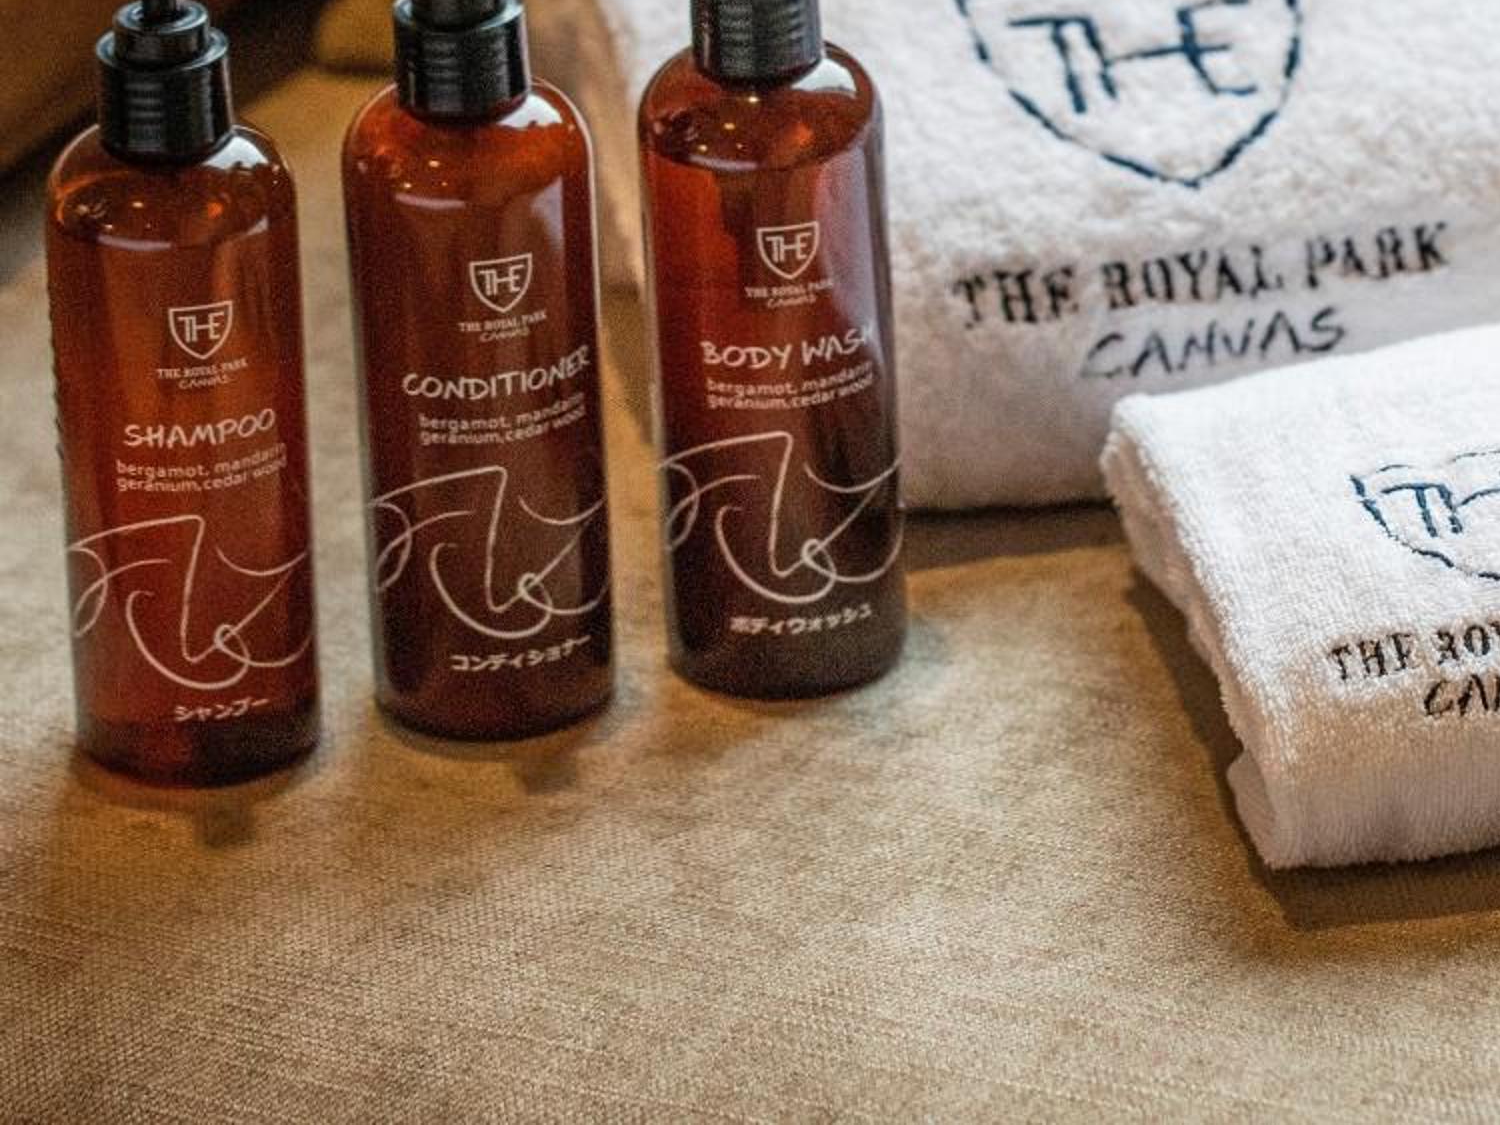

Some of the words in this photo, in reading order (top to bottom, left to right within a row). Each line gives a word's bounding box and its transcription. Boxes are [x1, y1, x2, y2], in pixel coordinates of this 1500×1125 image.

[766, 232, 811, 263] THE
[479, 265, 524, 295] THE
[953, 264, 1079, 329] THE
[1099, 245, 1284, 312] ROYAL
[1305, 221, 1449, 288] PARK
[178, 312, 224, 342] THE
[1081, 306, 1346, 378] CANVAS
[402, 345, 591, 400] CONDITIONER
[700, 340, 792, 370] BODY
[124, 408, 275, 449] SHAMPOO
[1326, 632, 1421, 681] THE
